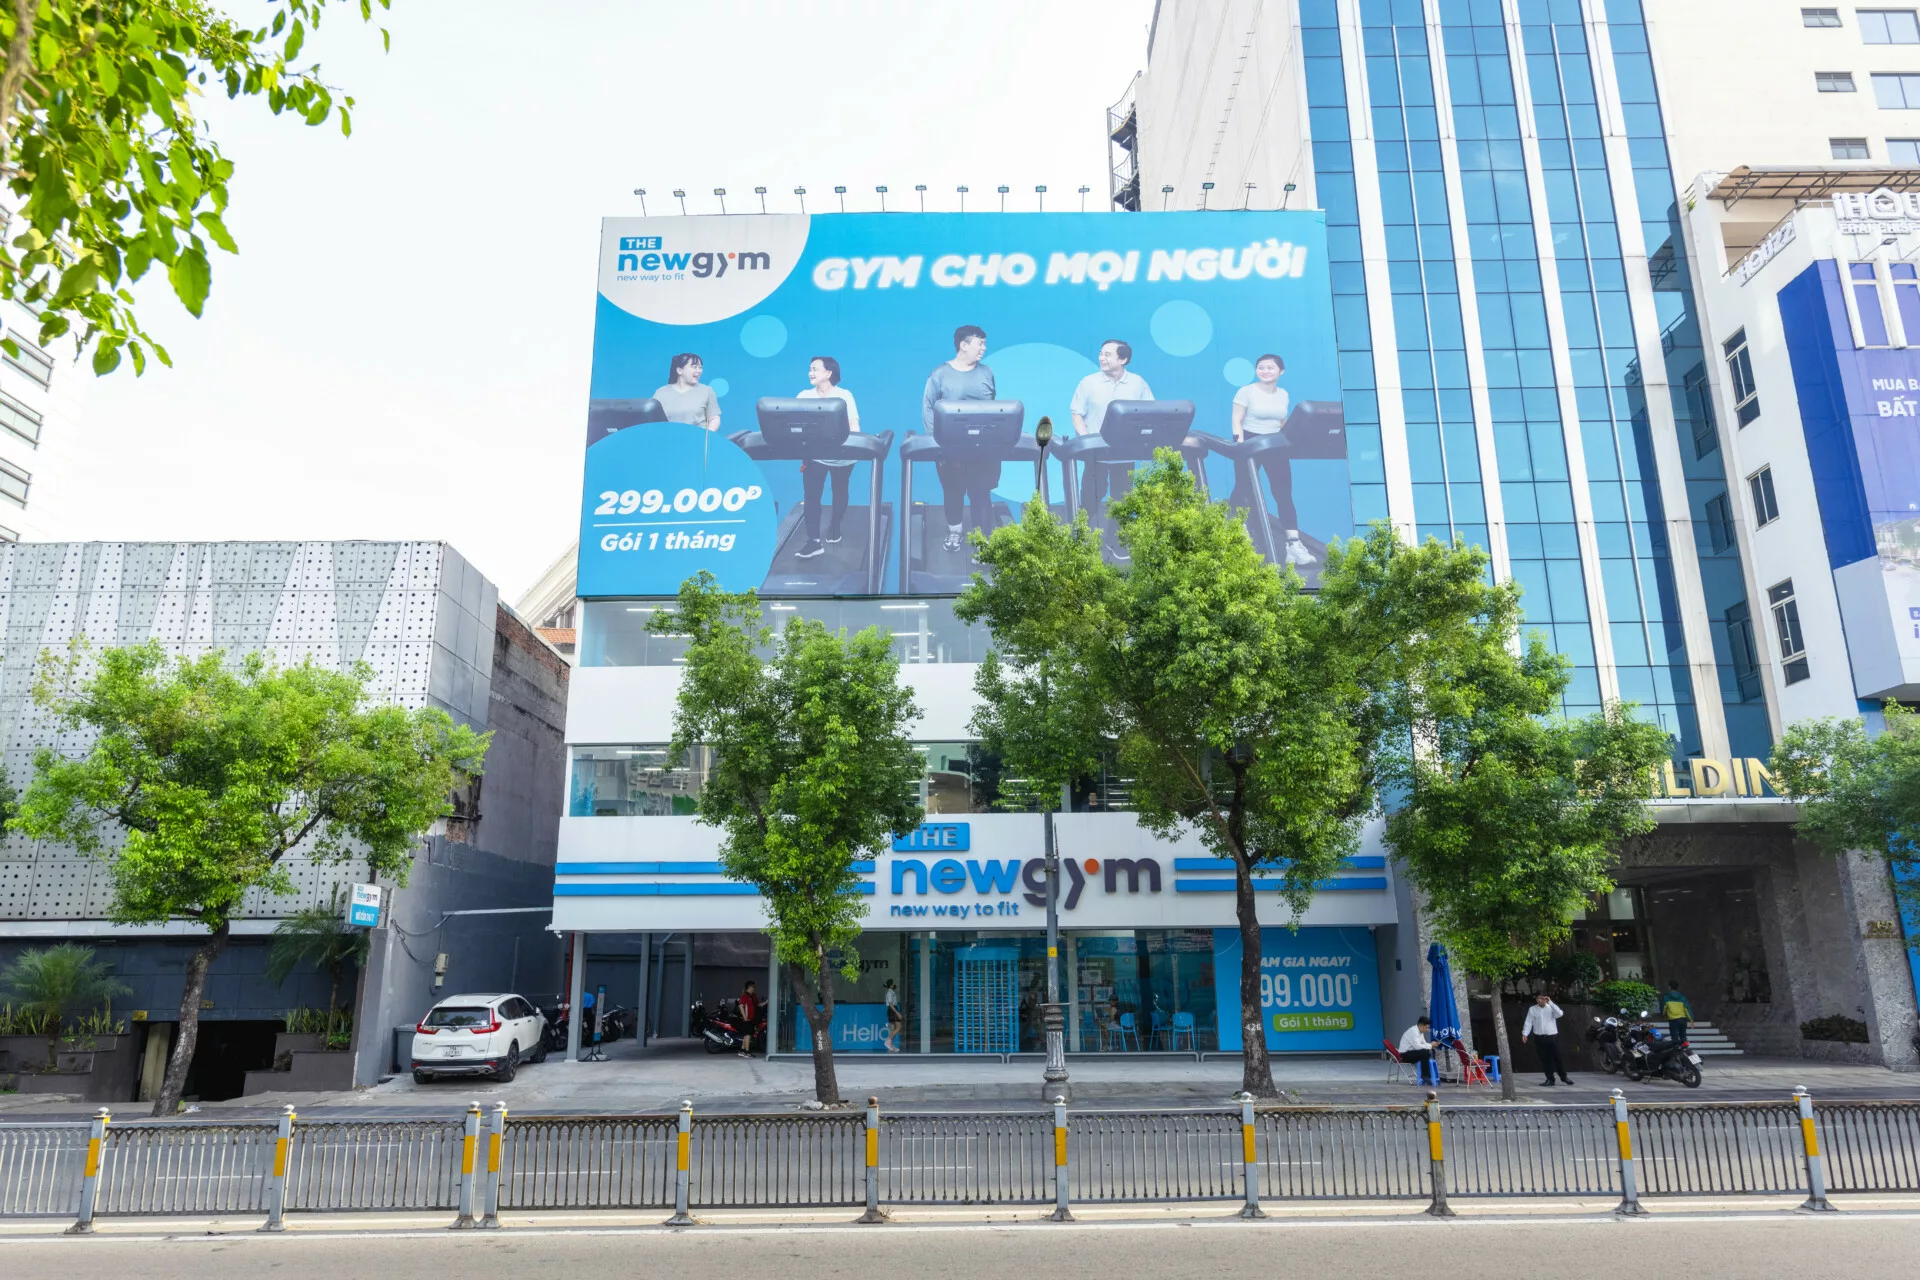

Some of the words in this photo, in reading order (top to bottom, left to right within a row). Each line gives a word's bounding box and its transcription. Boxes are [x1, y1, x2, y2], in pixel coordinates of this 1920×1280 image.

[626, 238, 656, 248] THE
[812, 256, 921, 290] GYM
[931, 253, 1036, 286] CHO
[1045, 251, 1139, 291] MỌI
[1147, 239, 1307, 282] NGƯỜI
[639, 275, 660, 283] way
[674, 272, 684, 281] fit
[1872, 378, 1906, 391] MUA
[1908, 378, 1920, 391] B
[1877, 395, 1918, 418] BẤT
[600, 530, 643, 552] Gói
[648, 533, 659, 550] 1
[664, 530, 736, 553] tháng
[908, 826, 958, 847] THE
[891, 857, 1162, 910] newgym
[890, 904, 930, 916] new
[932, 905, 970, 919] way
[975, 902, 994, 916] to
[998, 901, 1019, 916] fit
[1282, 956, 1306, 968] GIA
[1309, 956, 1351, 967] NGAY!
[1280, 1015, 1300, 1028] Gói
[1303, 1015, 1309, 1027] 1
[1312, 1013, 1348, 1029] tháng
